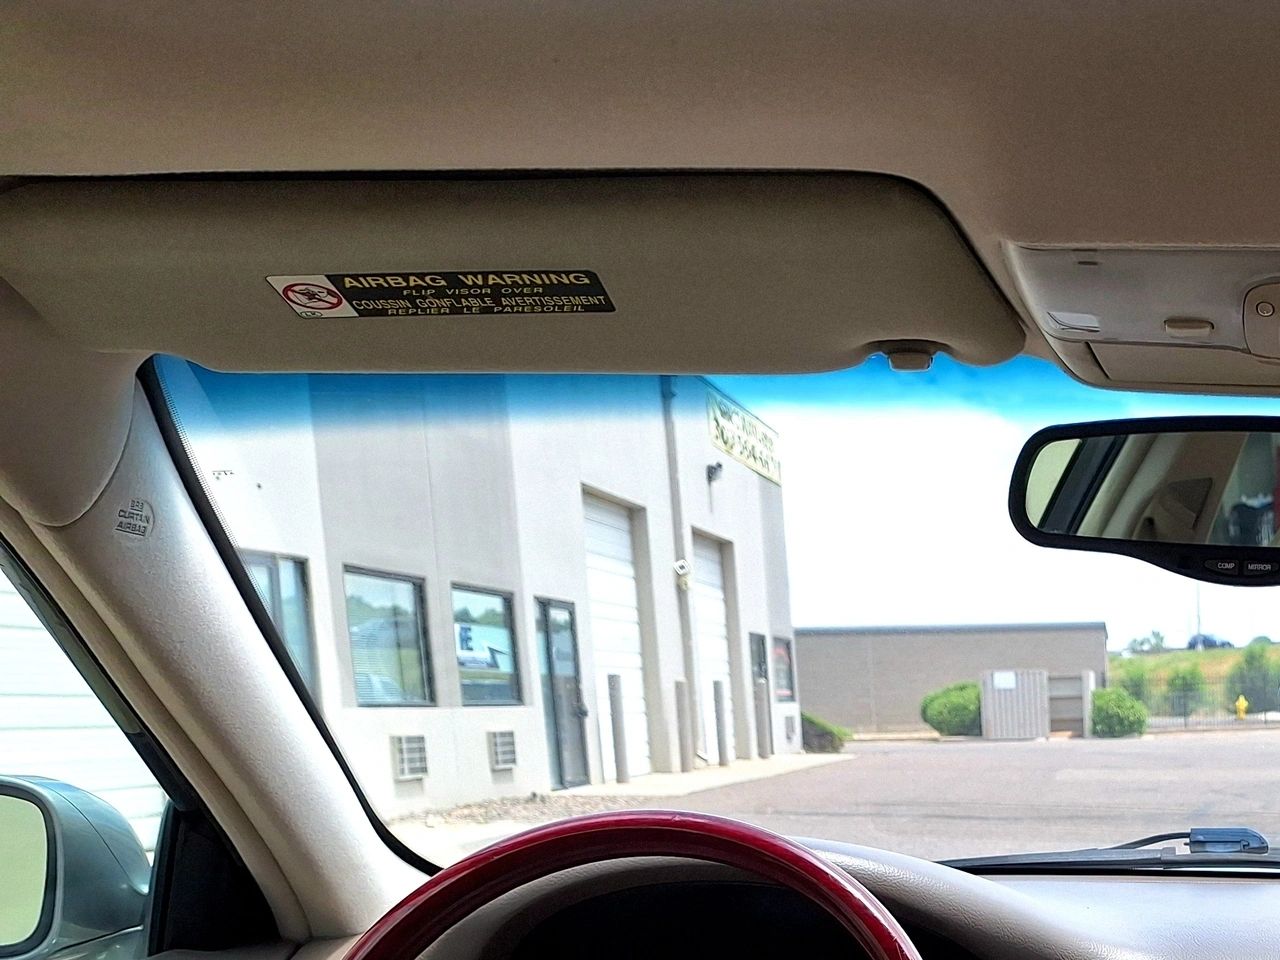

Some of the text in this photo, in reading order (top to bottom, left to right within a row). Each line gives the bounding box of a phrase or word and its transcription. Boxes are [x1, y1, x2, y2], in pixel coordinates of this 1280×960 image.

[344, 273, 590, 288] AIRBAG WARNING
[352, 295, 606, 310] COUSSIN GONFLABLE AVERTISSEMENT
[494, 305, 585, 313] PARESOLEIL
[1247, 563, 1271, 571] MIRROR
